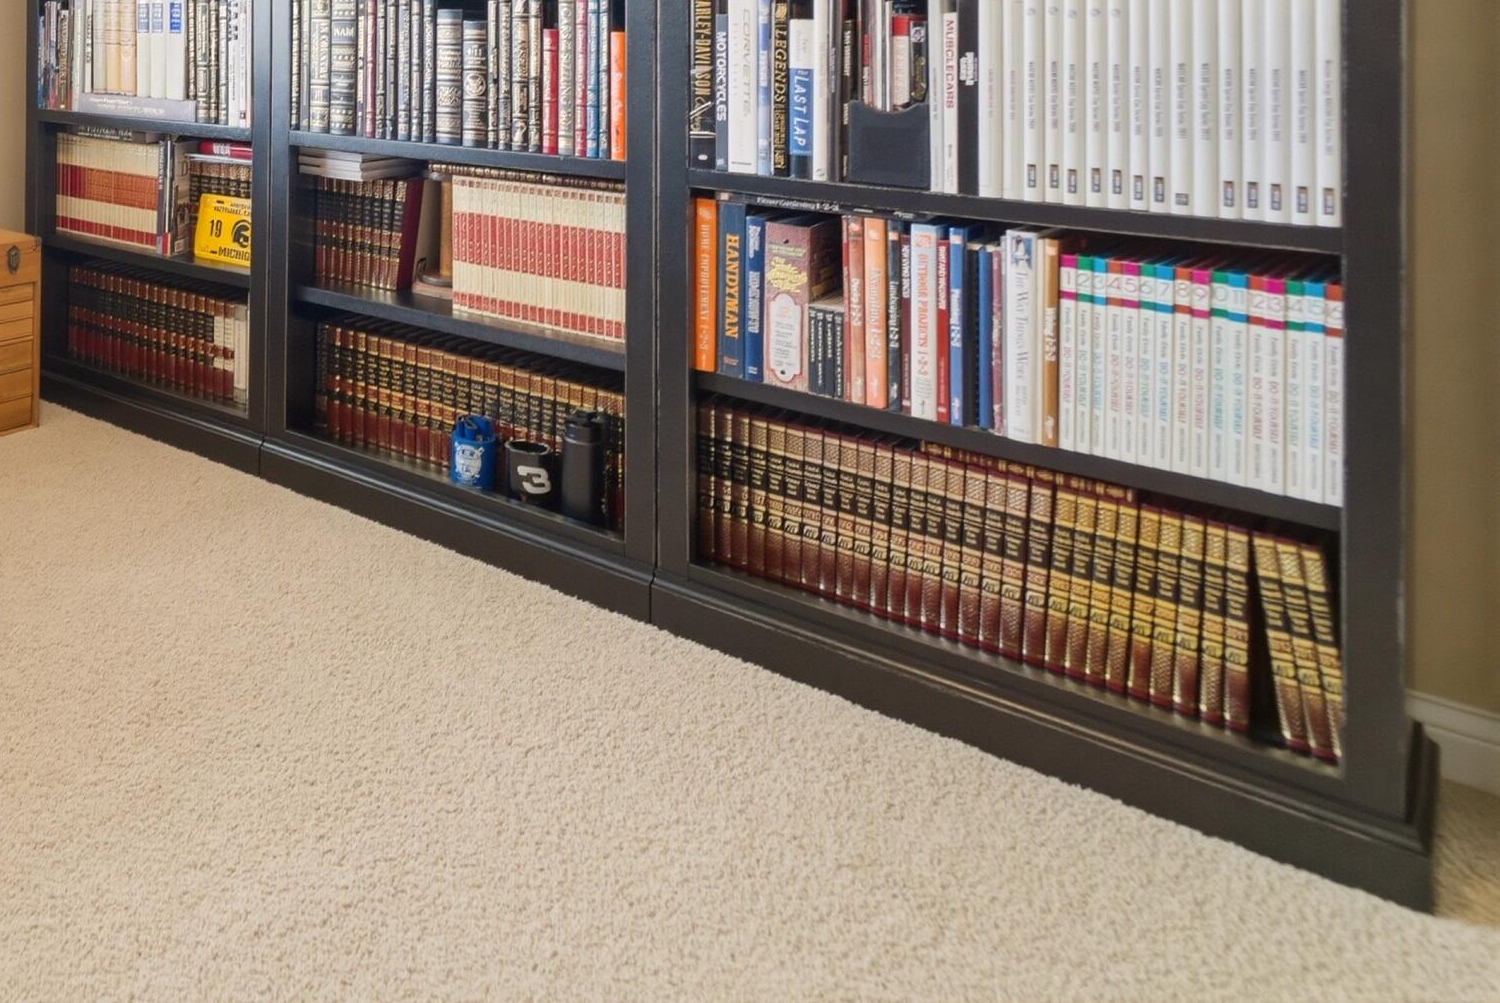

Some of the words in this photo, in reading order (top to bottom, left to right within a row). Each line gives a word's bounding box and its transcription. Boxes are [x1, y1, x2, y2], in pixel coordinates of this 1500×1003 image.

[333, 26, 355, 37] NAM
[716, 31, 727, 122] MOTORCYCLES
[742, 8, 752, 116] CORVETTE
[774, 29, 788, 102] LEGENDS
[945, 19, 955, 109] MUSCLECARS
[793, 76, 808, 115] LAST
[794, 117, 808, 147] LAP
[210, 219, 223, 238] 19
[699, 224, 710, 250] HOME
[699, 254, 710, 320] IMPROVEMENT
[725, 233, 740, 338] HANDYMAN
[917, 253, 928, 296] OUTDOOR
[1124, 278, 1138, 293] 5
[1158, 281, 1170, 296] 7
[1016, 291, 1029, 313] WAY
[1176, 282, 1190, 298] 8
[699, 325, 710, 350] 1-2-3
[917, 300, 928, 348] PROJECTS
[1016, 316, 1029, 349] THINGS
[917, 351, 928, 376] 1-2-3
[1016, 352, 1029, 379] WORK
[517, 465, 552, 495] 3
